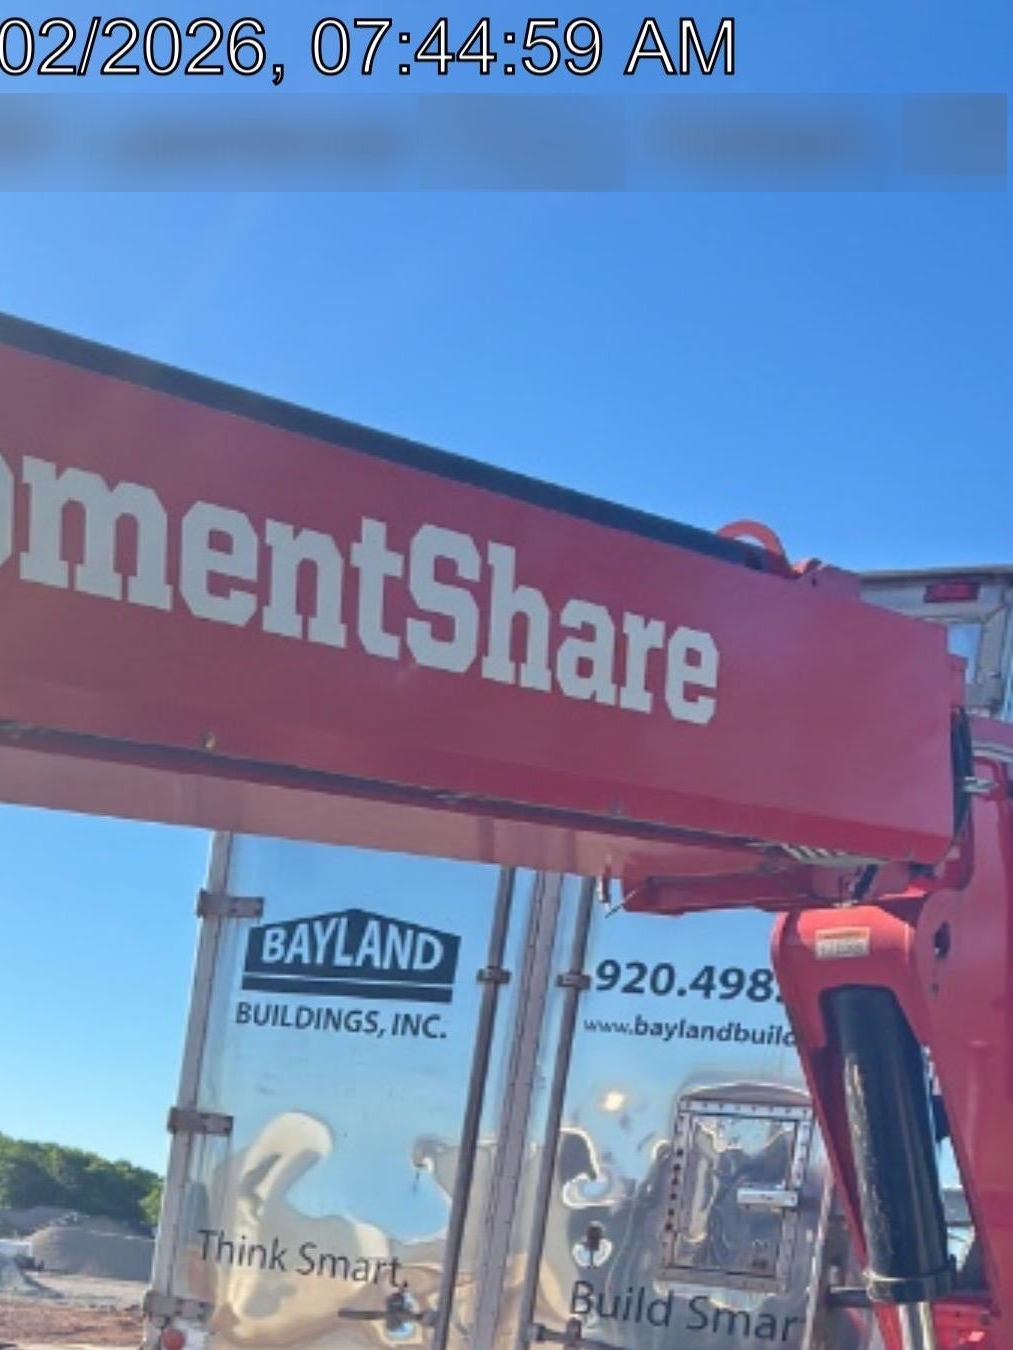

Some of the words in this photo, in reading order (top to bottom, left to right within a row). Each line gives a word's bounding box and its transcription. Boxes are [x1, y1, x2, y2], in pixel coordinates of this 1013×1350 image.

[261, 917, 444, 971] BAYLAND
[236, 1001, 387, 1039] BUILDINGS,
[391, 1013, 448, 1039] INC.
[198, 1229, 286, 1272] Think
[296, 1241, 409, 1289] Smart.
[569, 1280, 674, 1328] Build
[685, 1295, 807, 1343] Smar
